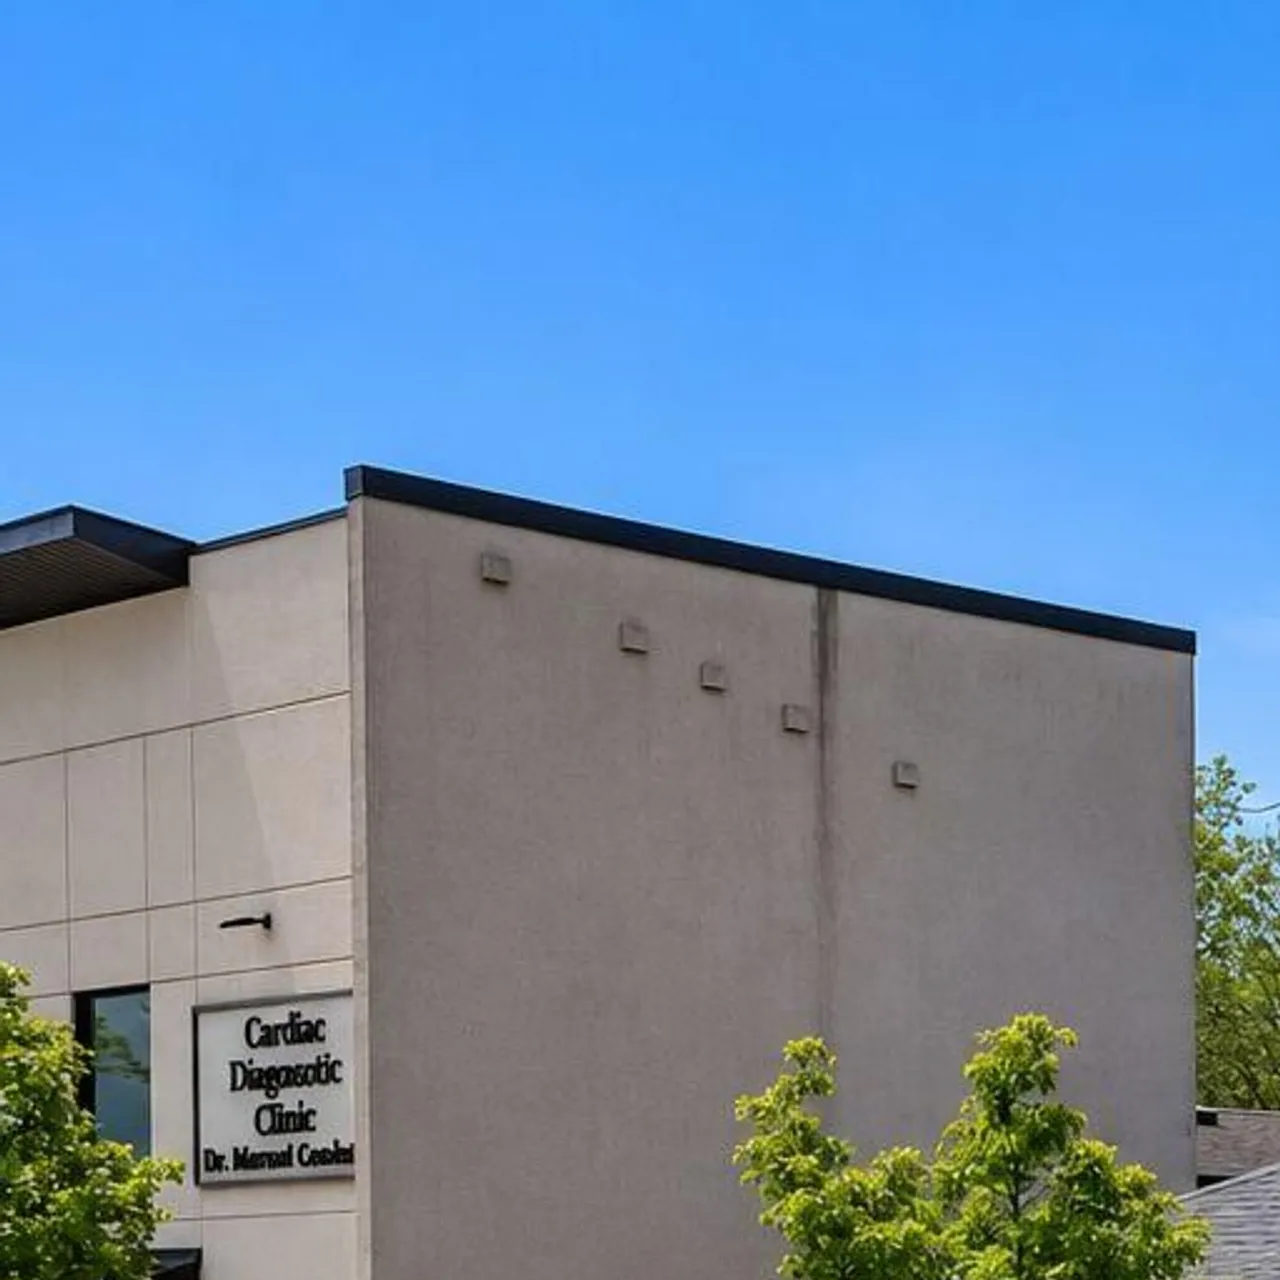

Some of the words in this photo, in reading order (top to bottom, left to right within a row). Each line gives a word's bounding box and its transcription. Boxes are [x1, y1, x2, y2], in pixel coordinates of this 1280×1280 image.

[245, 1011, 326, 1048] Cardiac
[255, 1100, 317, 1136] Clinic
[203, 1148, 230, 1172] Dr.
